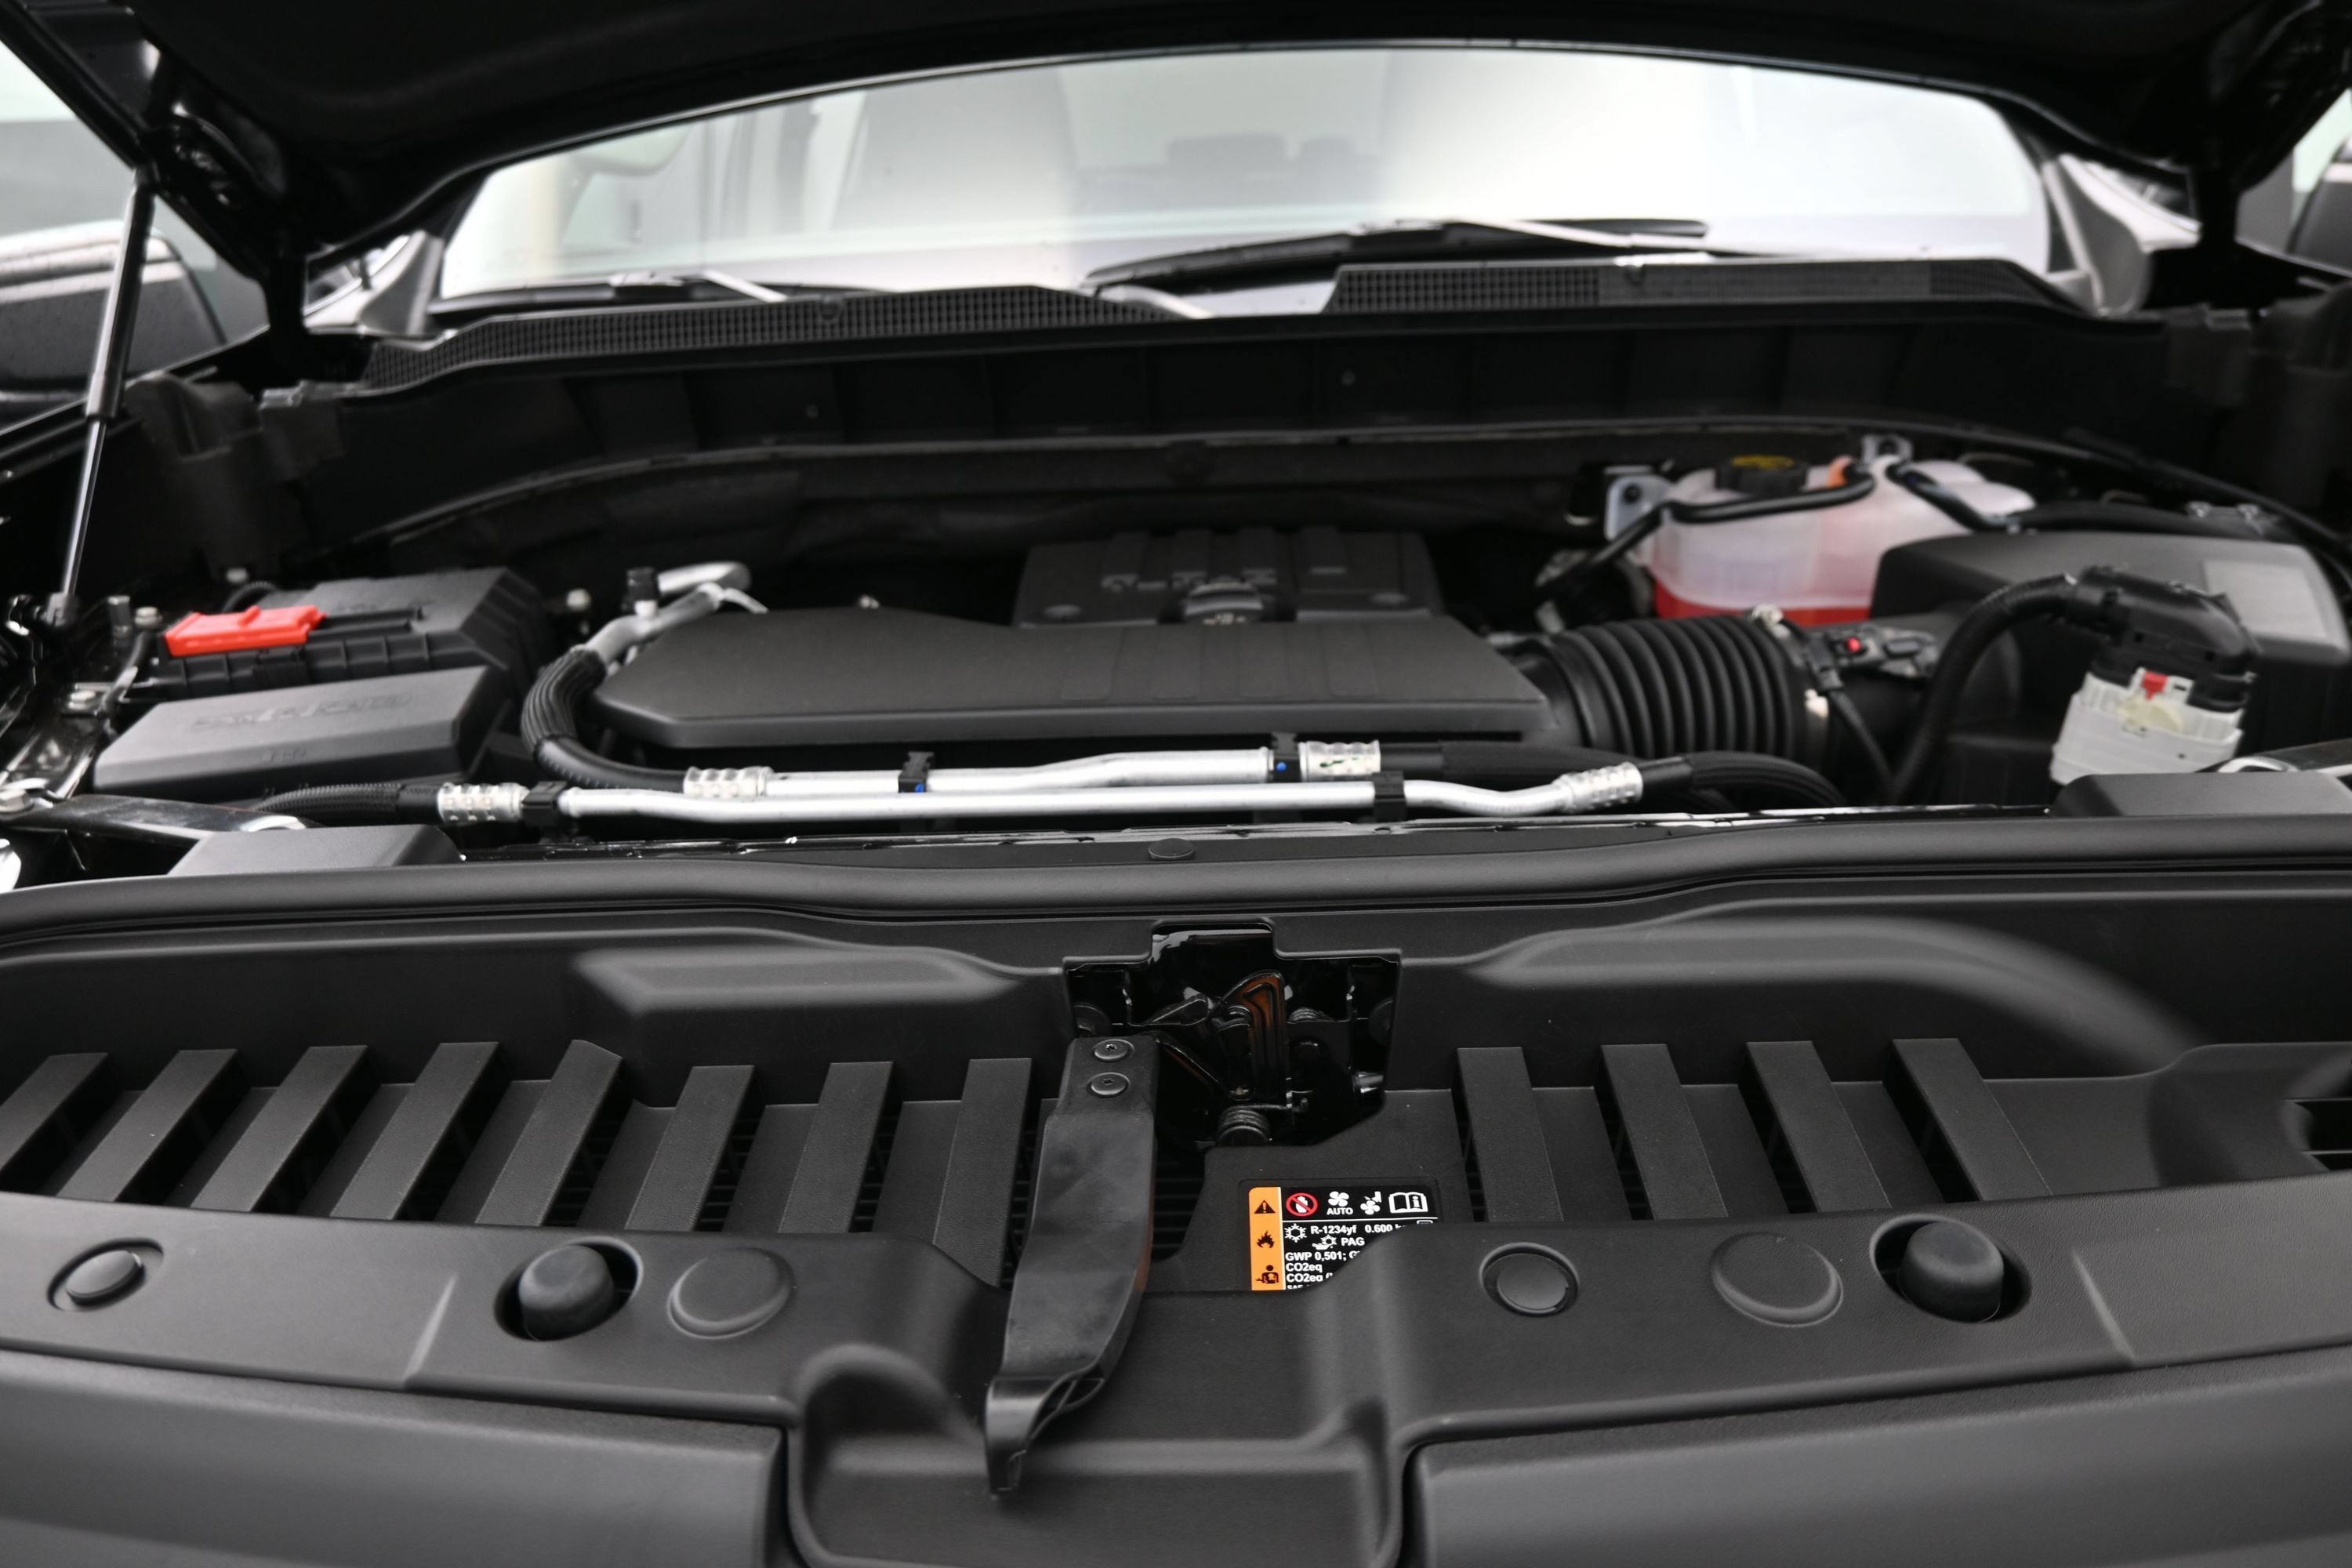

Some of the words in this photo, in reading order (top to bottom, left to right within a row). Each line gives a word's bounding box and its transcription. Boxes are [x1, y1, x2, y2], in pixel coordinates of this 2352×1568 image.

[1311, 1225, 1357, 1236] R-1234yf
[1364, 1224, 1393, 1233] 0.600
[1341, 1237, 1365, 1246] PAG
[1285, 1252, 1312, 1261] GWP
[1286, 1262, 1323, 1273] CO2eq
